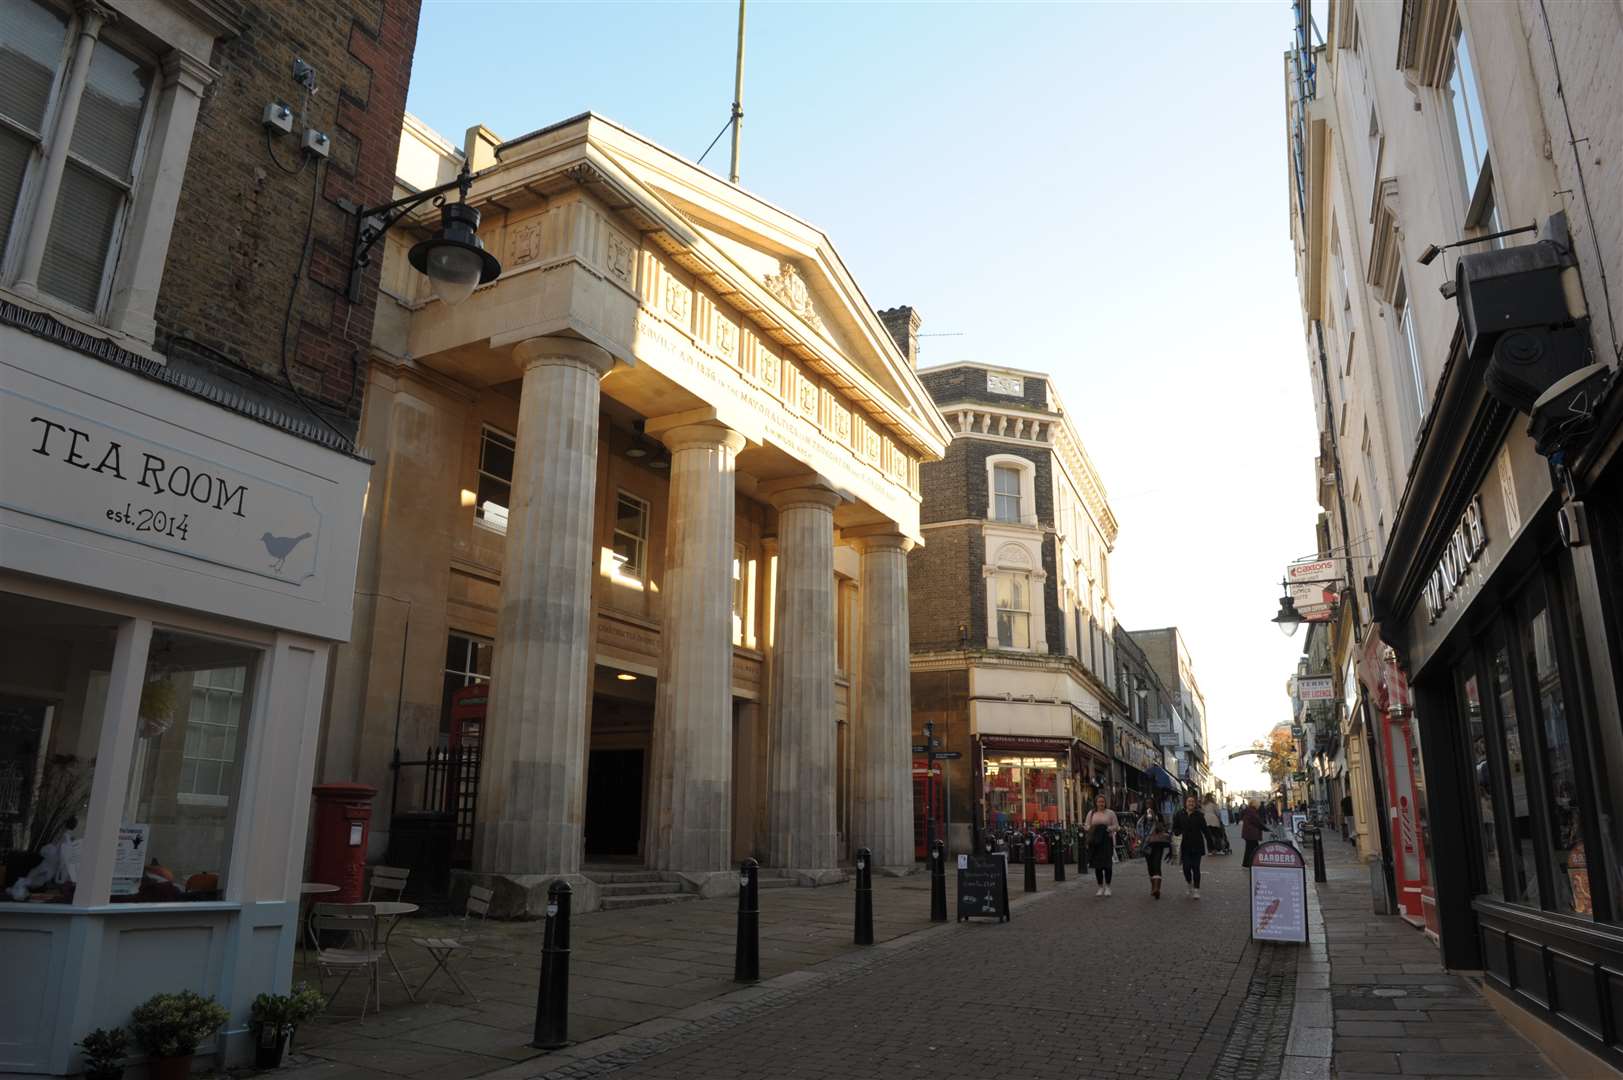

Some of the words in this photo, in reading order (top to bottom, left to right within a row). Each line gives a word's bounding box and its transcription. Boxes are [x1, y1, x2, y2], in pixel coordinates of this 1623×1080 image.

[30, 416, 127, 481] TEA
[137, 452, 248, 518] ROOM
[1422, 568, 1443, 625] TOP
[1258, 853, 1296, 863] BARBERS
